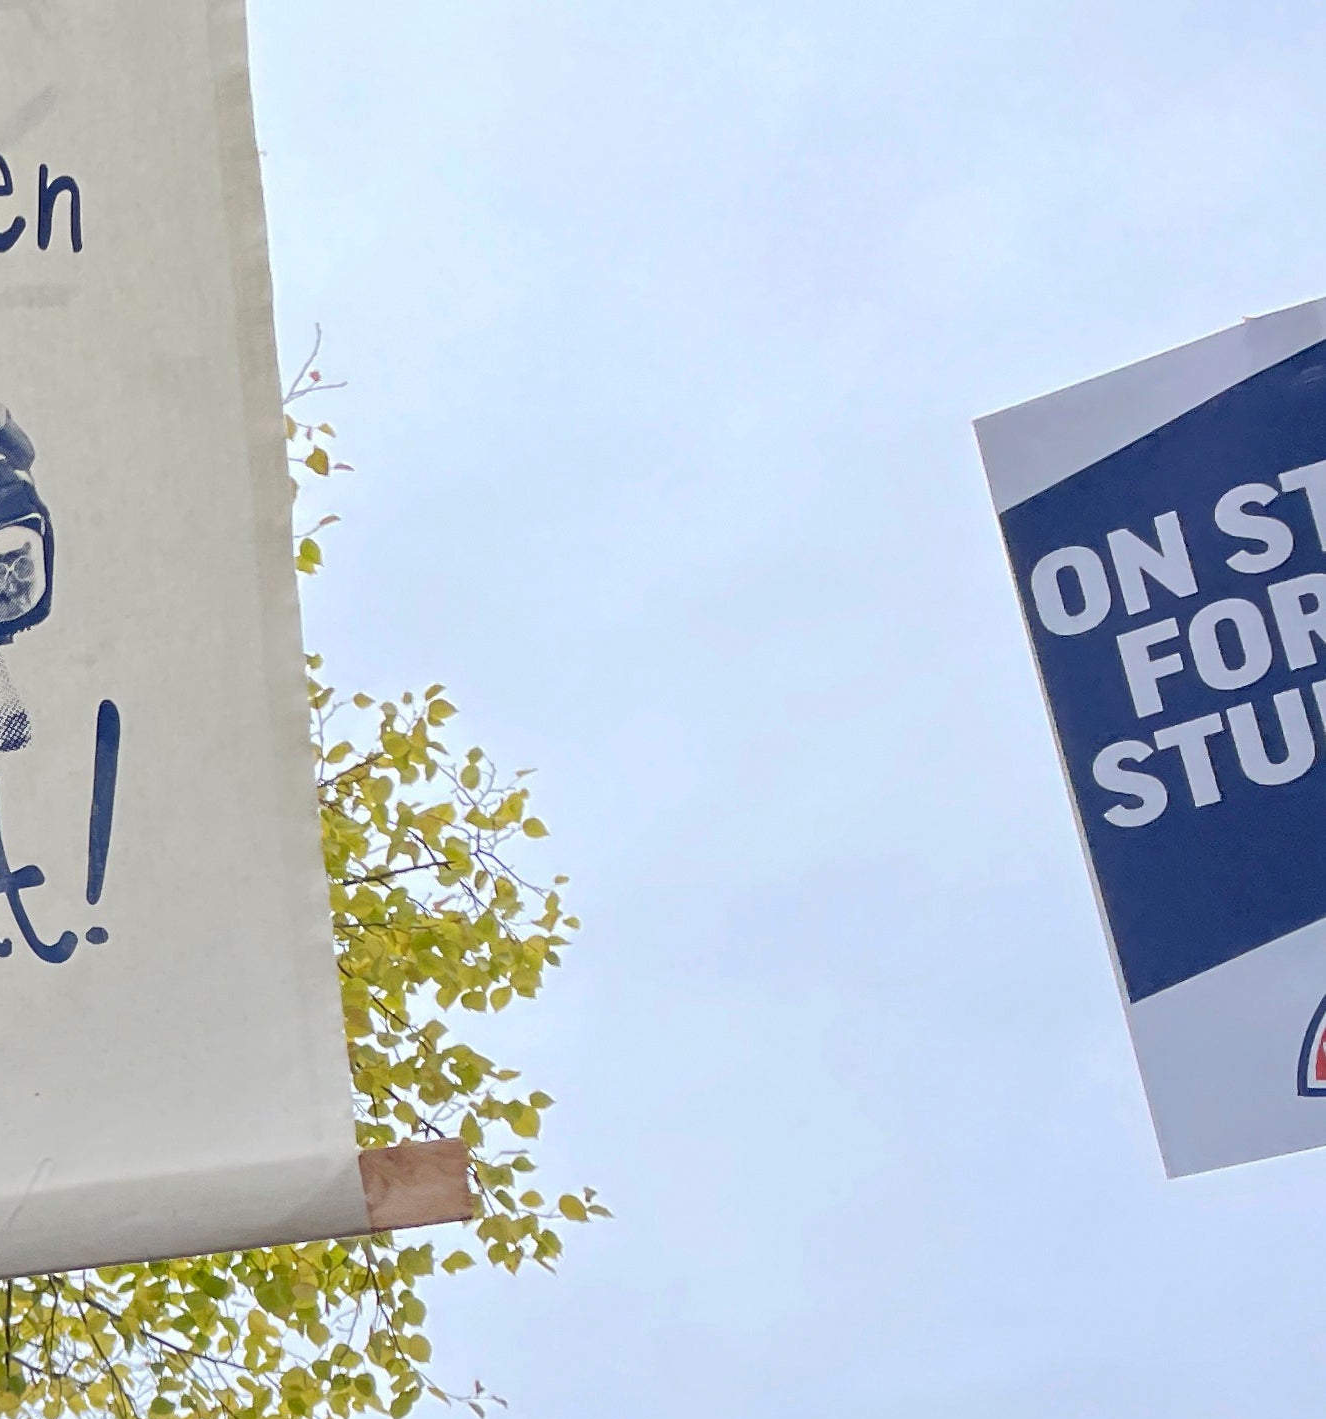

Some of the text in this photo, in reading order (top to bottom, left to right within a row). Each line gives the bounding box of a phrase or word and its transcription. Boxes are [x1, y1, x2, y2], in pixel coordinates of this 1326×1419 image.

[1029, 510, 1199, 638] ON
[1116, 572, 1326, 719] FOR
[1092, 679, 1326, 829] STU
